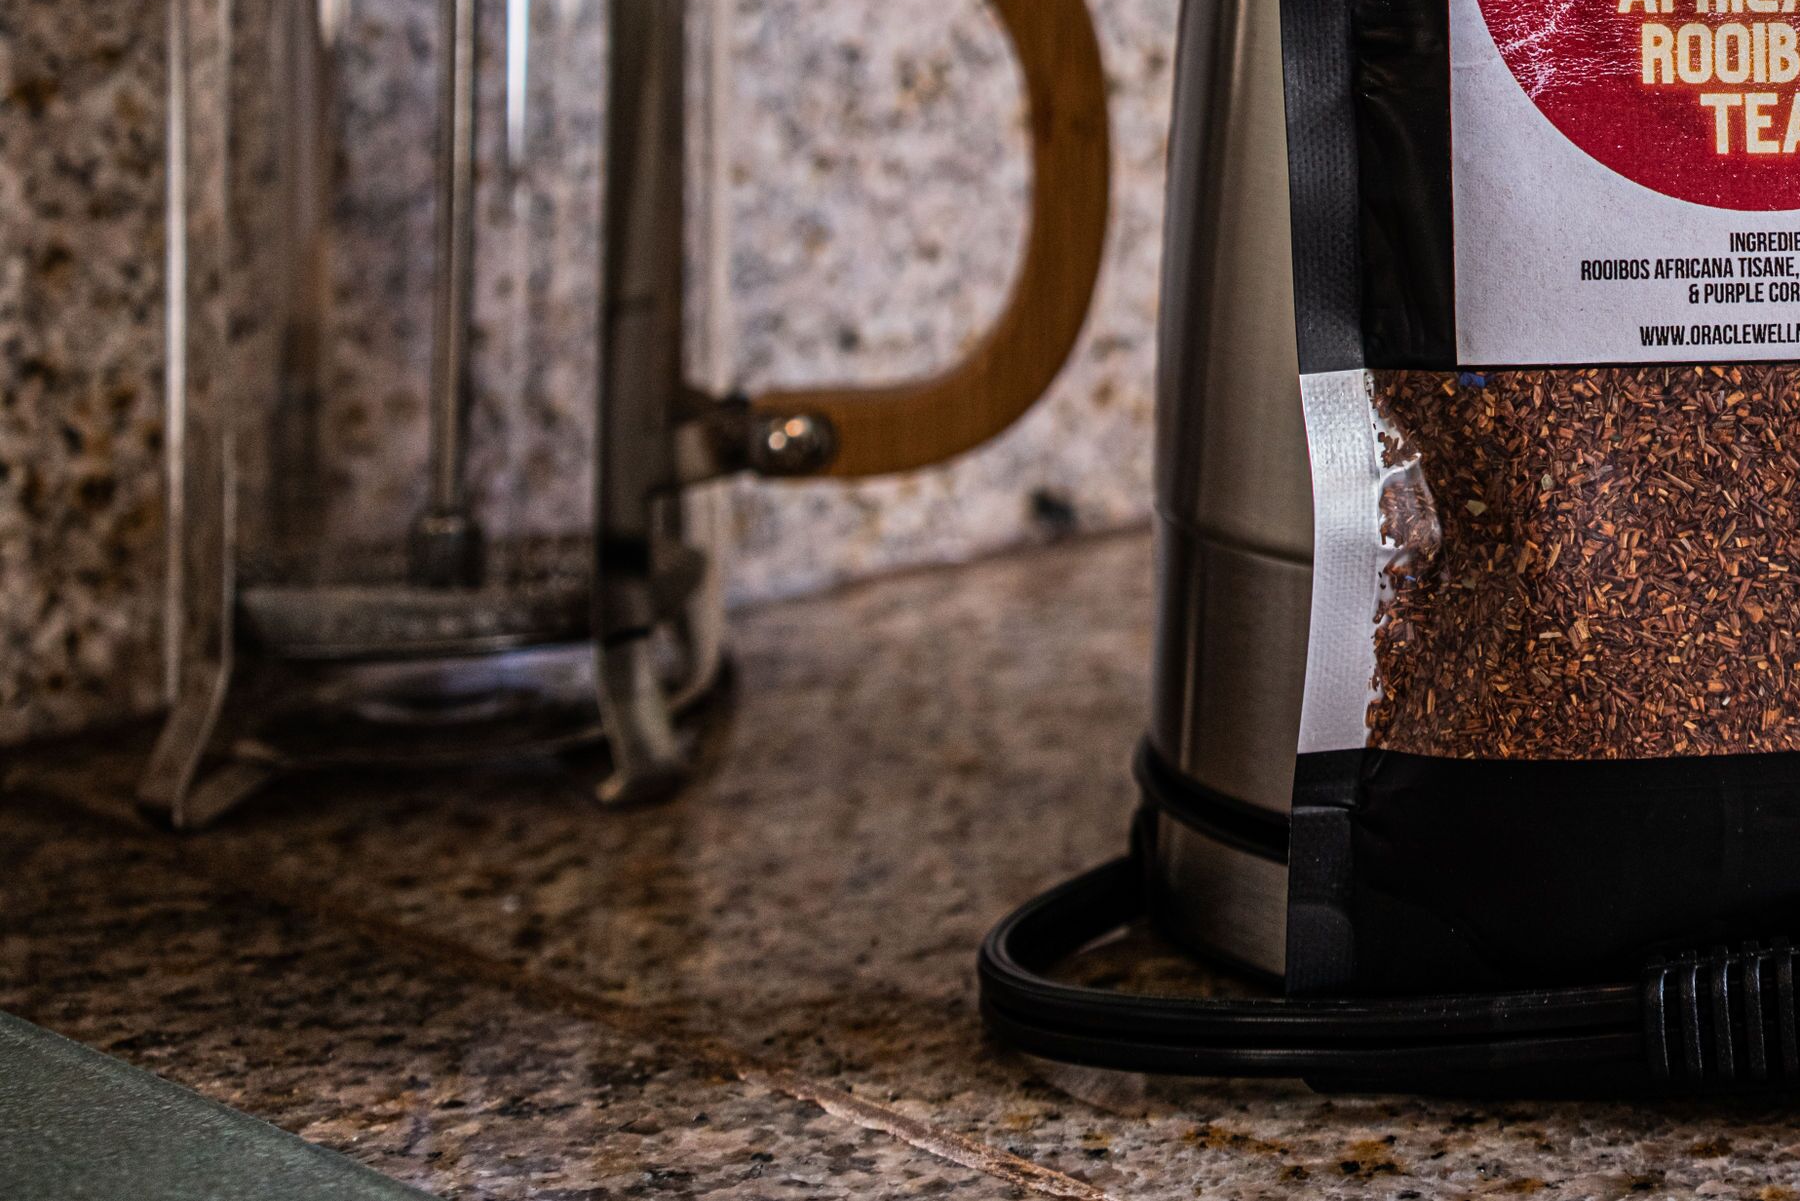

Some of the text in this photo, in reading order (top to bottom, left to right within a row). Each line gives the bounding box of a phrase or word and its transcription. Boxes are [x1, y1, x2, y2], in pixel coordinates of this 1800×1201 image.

[1580, 258, 1650, 281] ROOIBOS
[1654, 257, 1734, 280] AFRICANA
[1738, 256, 1800, 280] TISANE,
[1688, 283, 1700, 304] &
[1704, 282, 1765, 304] PURPLE
